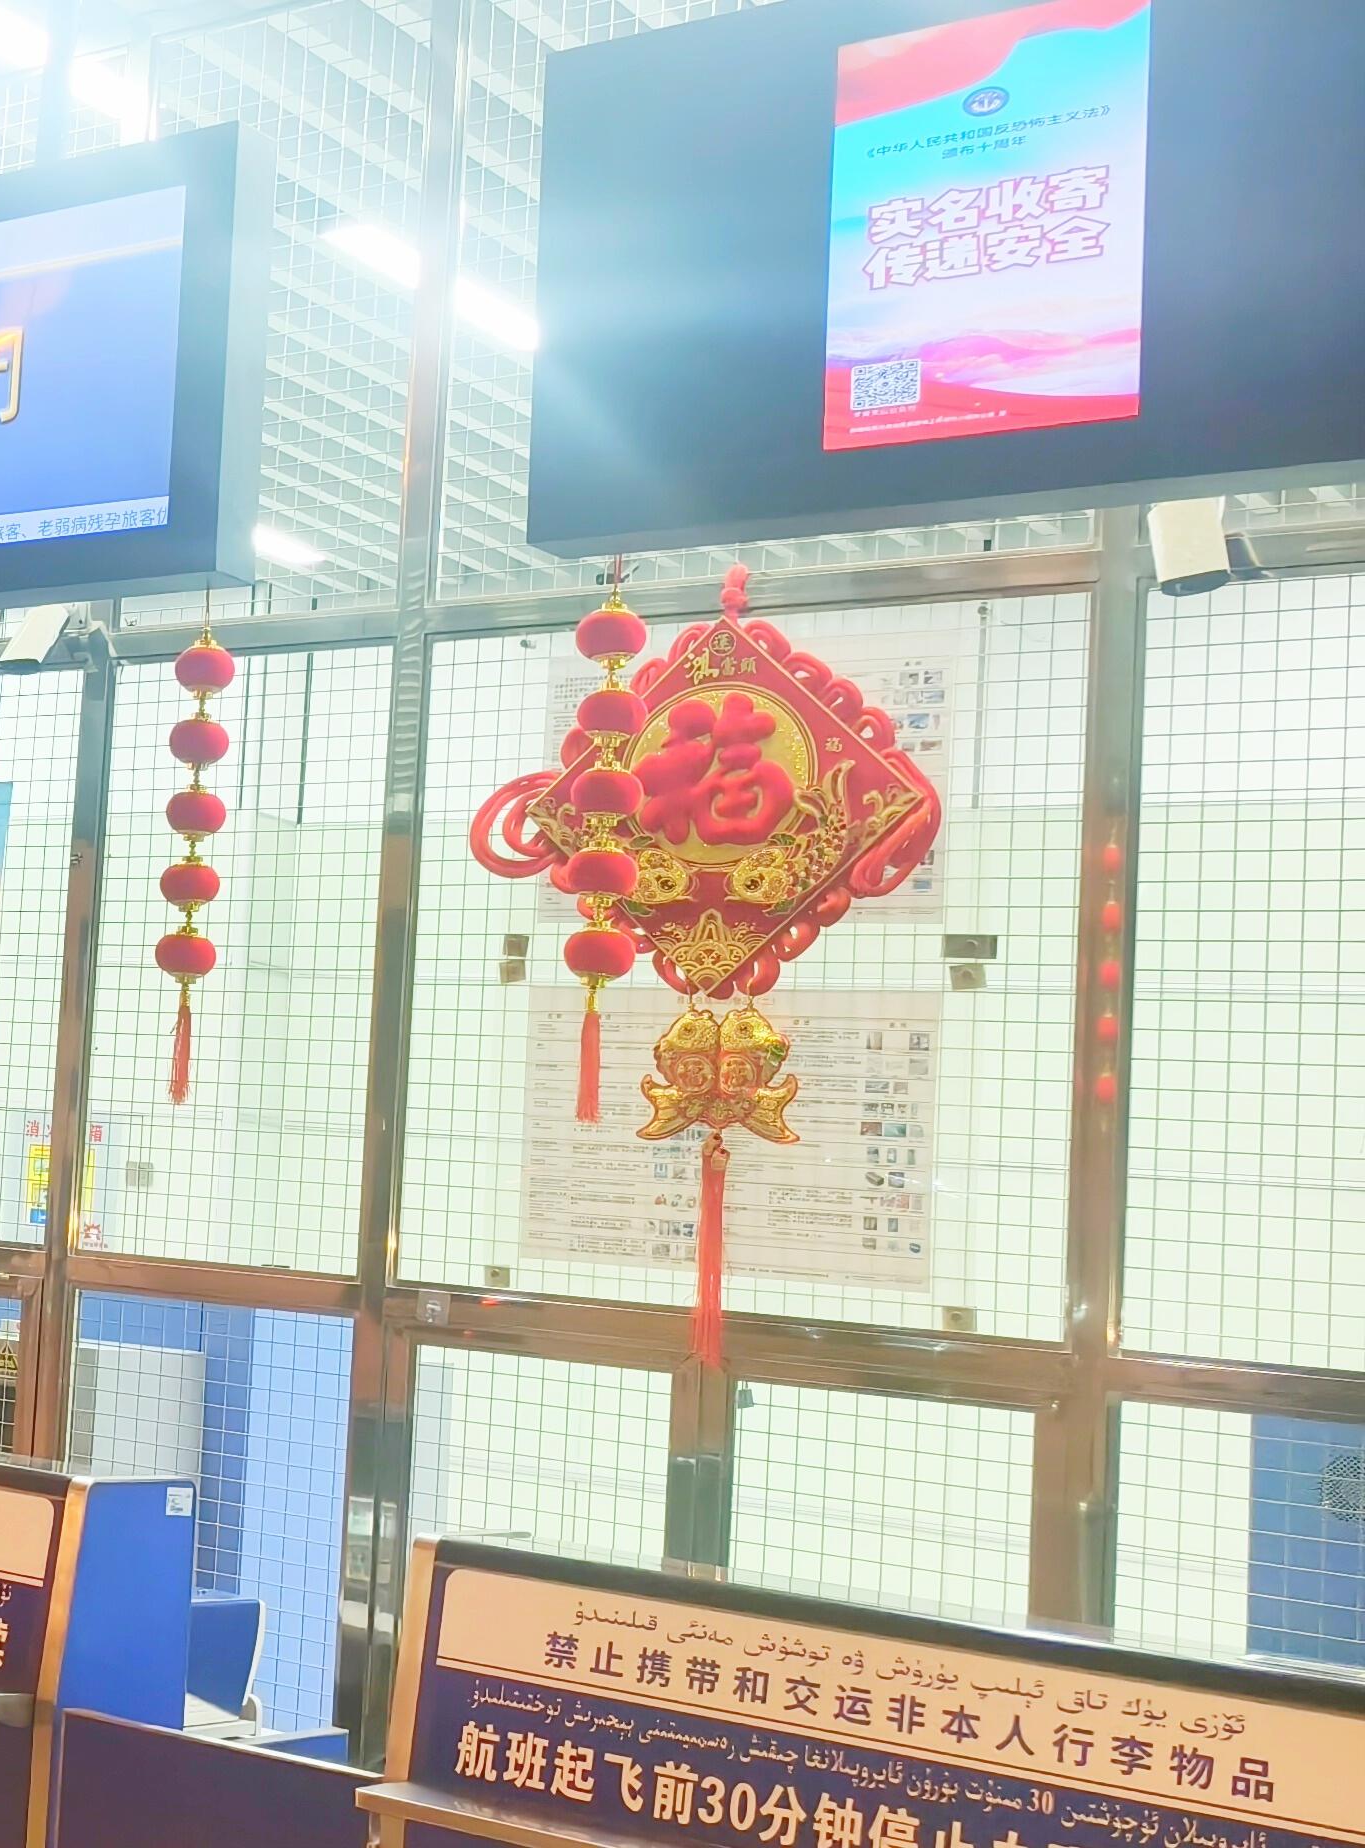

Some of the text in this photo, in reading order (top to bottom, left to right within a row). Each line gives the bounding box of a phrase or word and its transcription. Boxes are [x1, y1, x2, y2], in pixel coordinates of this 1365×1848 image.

[862, 215, 1111, 291] 传递安全
[868, 165, 1110, 244] 实名收寄
[635, 691, 797, 847] 福
[544, 1630, 1275, 1802] 禁止携带和交运非本人行李物品
[454, 1720, 1081, 1848] 航班起飞前30分钟停
[1026, 1788, 1055, 1815] 30
